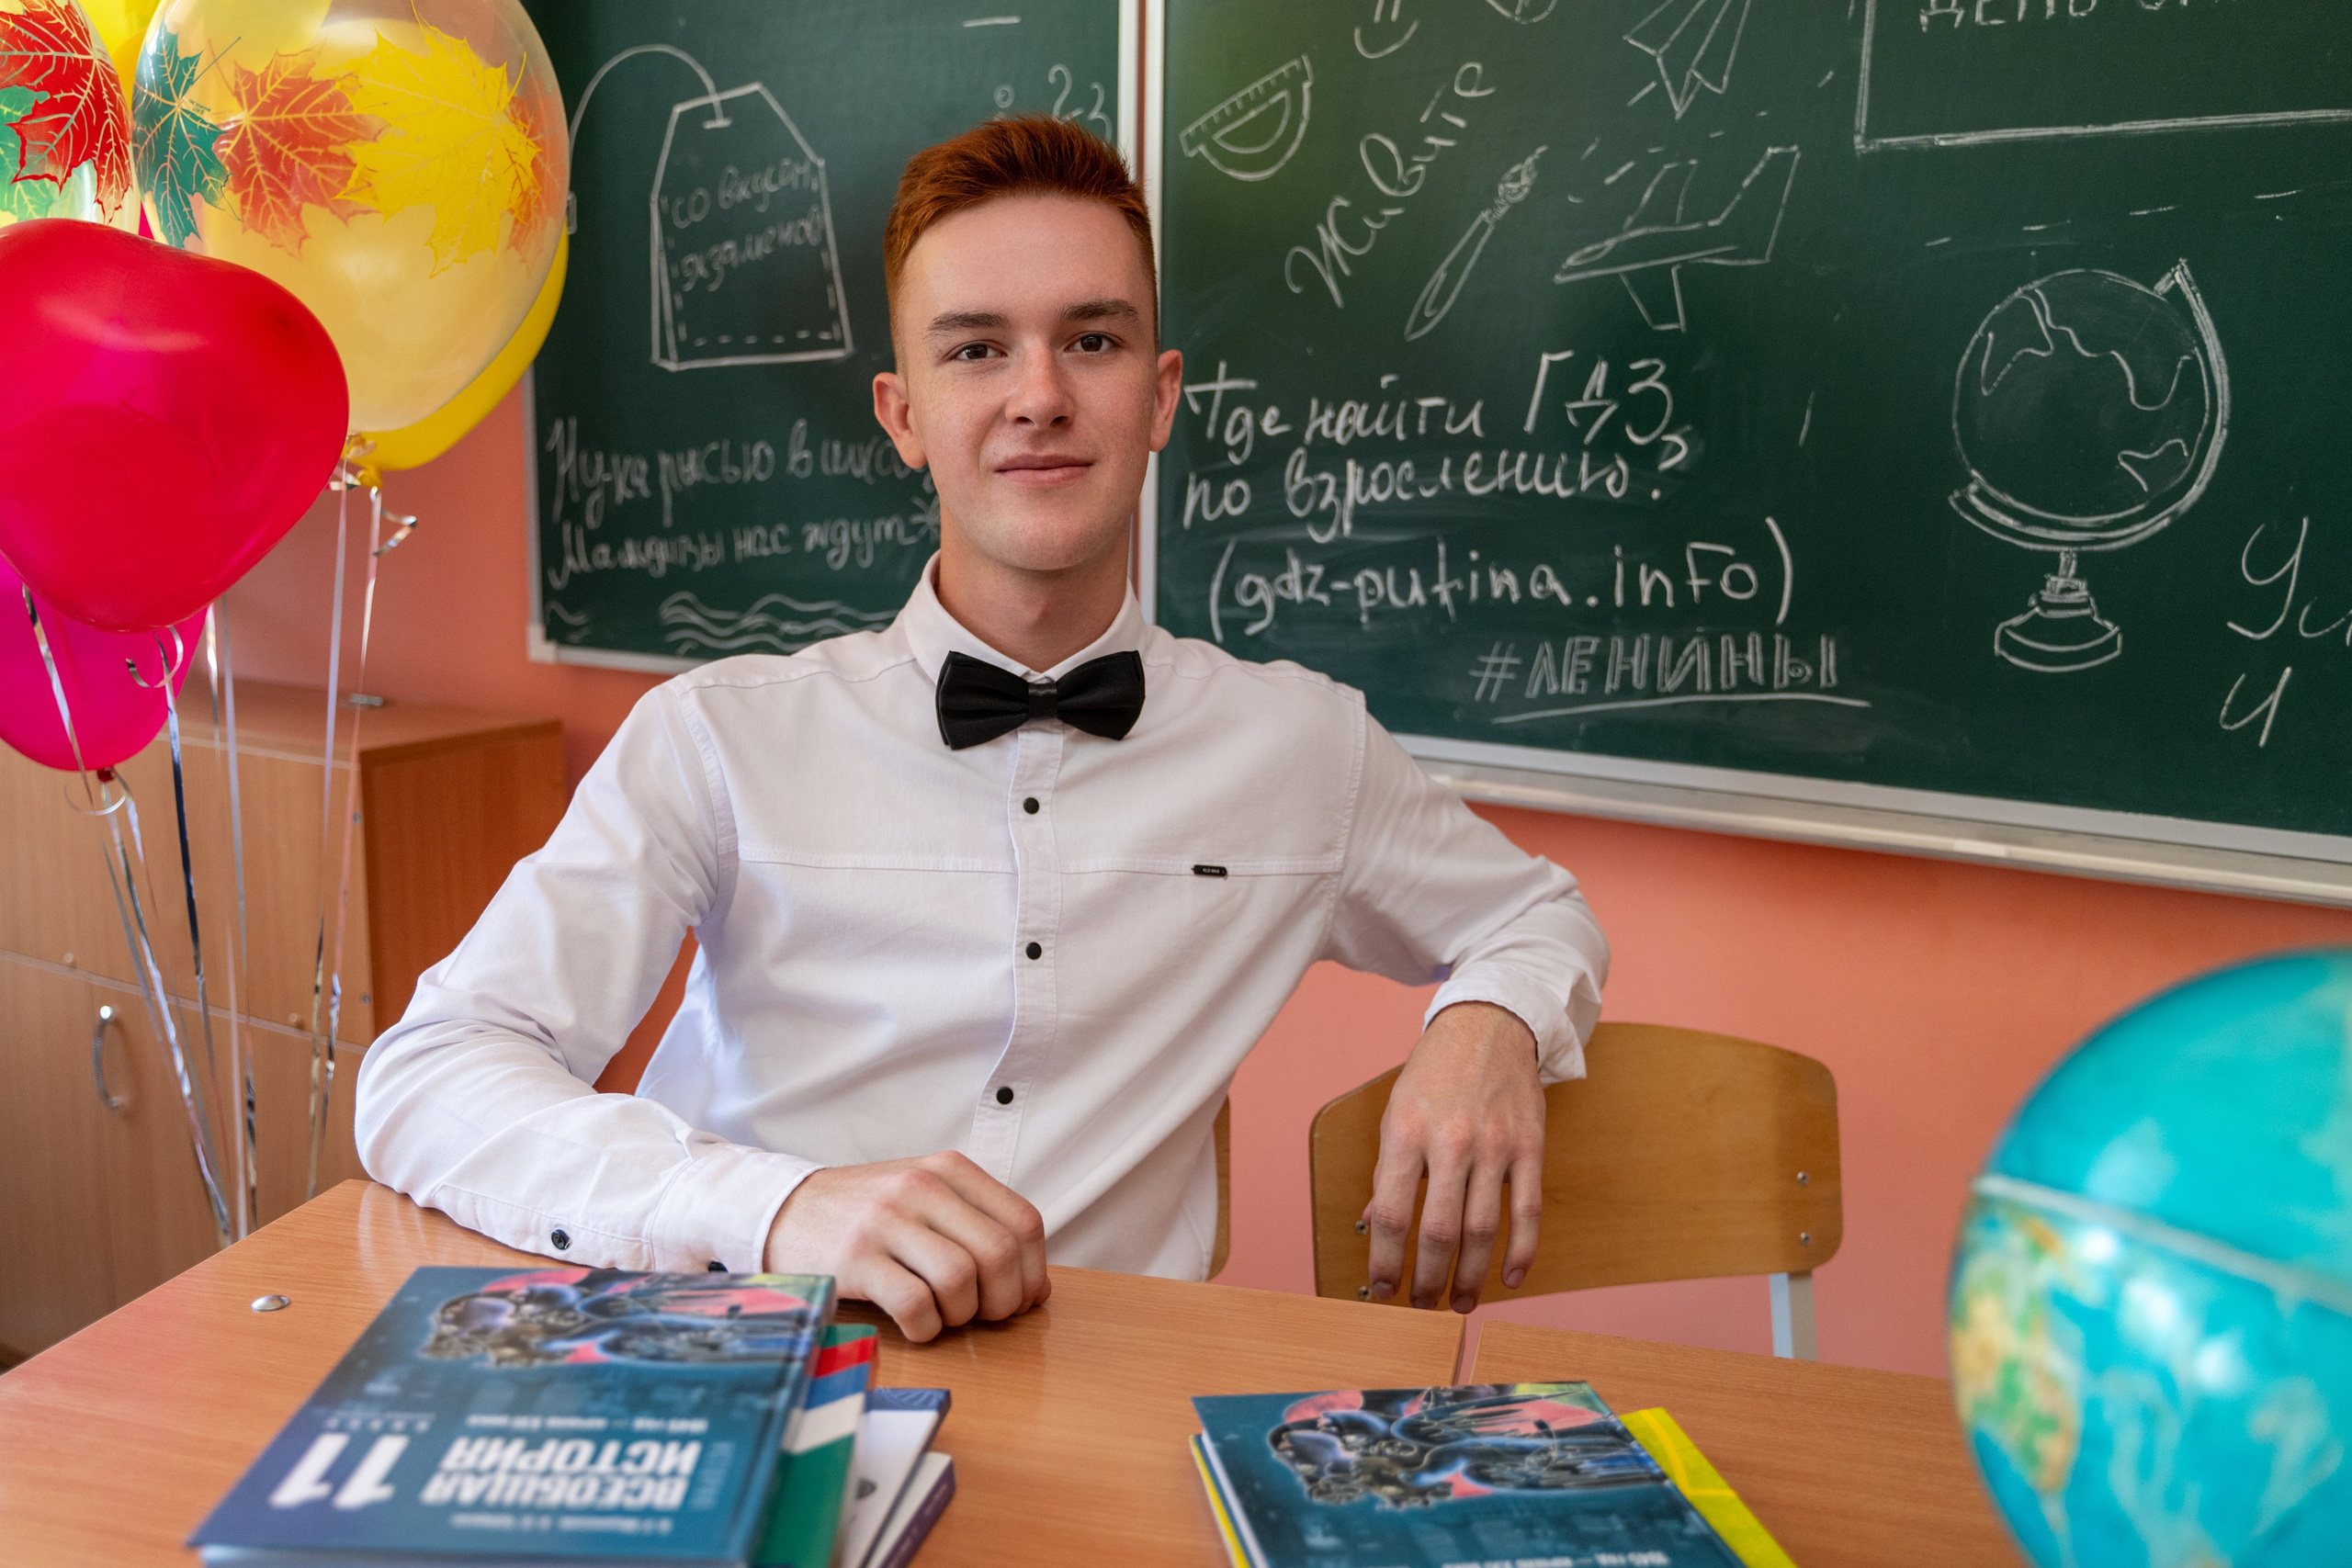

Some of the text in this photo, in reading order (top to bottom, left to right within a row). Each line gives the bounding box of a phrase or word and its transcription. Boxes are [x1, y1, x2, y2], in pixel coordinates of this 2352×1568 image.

[1304, 375, 1486, 446] найти
[1183, 471, 1253, 530] по
[268, 1431, 412, 1510] 11
[439, 1436, 704, 1475] ИСТОРИЯ
[420, 1471, 695, 1511] ВСЕОБЩАЯ
